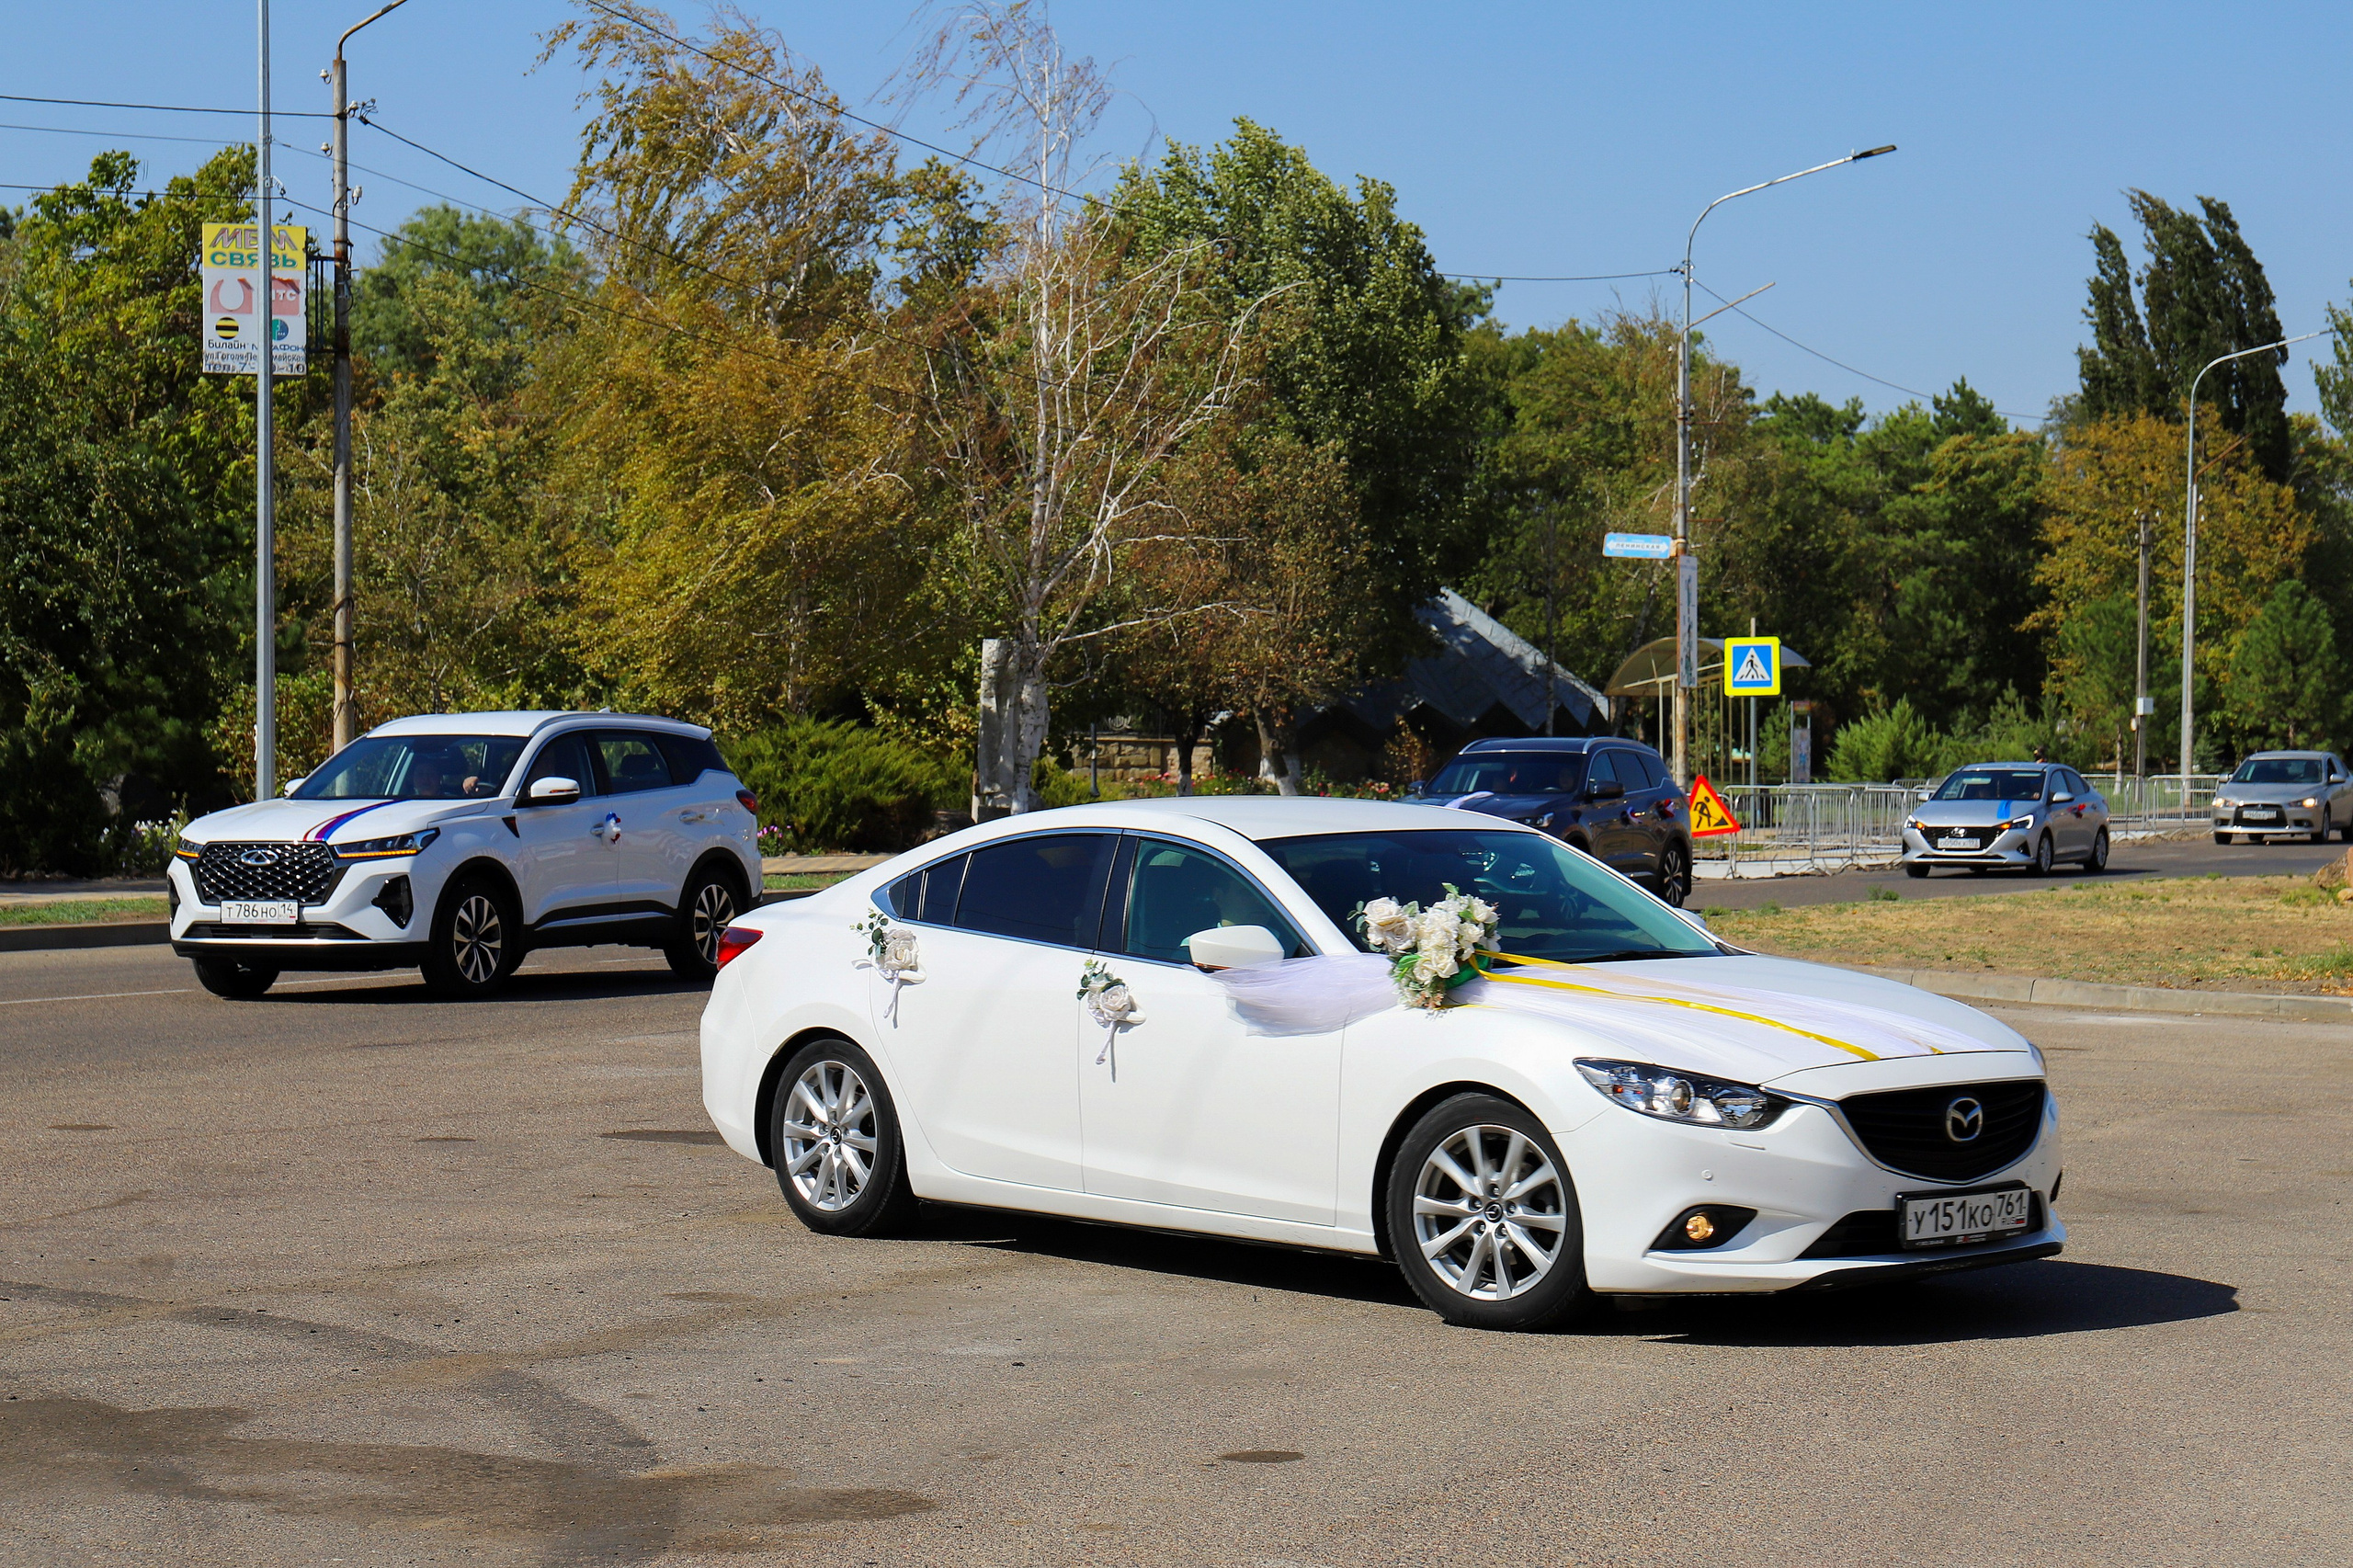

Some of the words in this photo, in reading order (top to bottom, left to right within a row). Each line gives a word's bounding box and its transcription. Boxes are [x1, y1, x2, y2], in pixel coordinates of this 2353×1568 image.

[271, 290, 297, 301] ТС
[208, 339, 246, 349] Билайн
[280, 903, 293, 915] 14
[1997, 1192, 2024, 1218] 761
